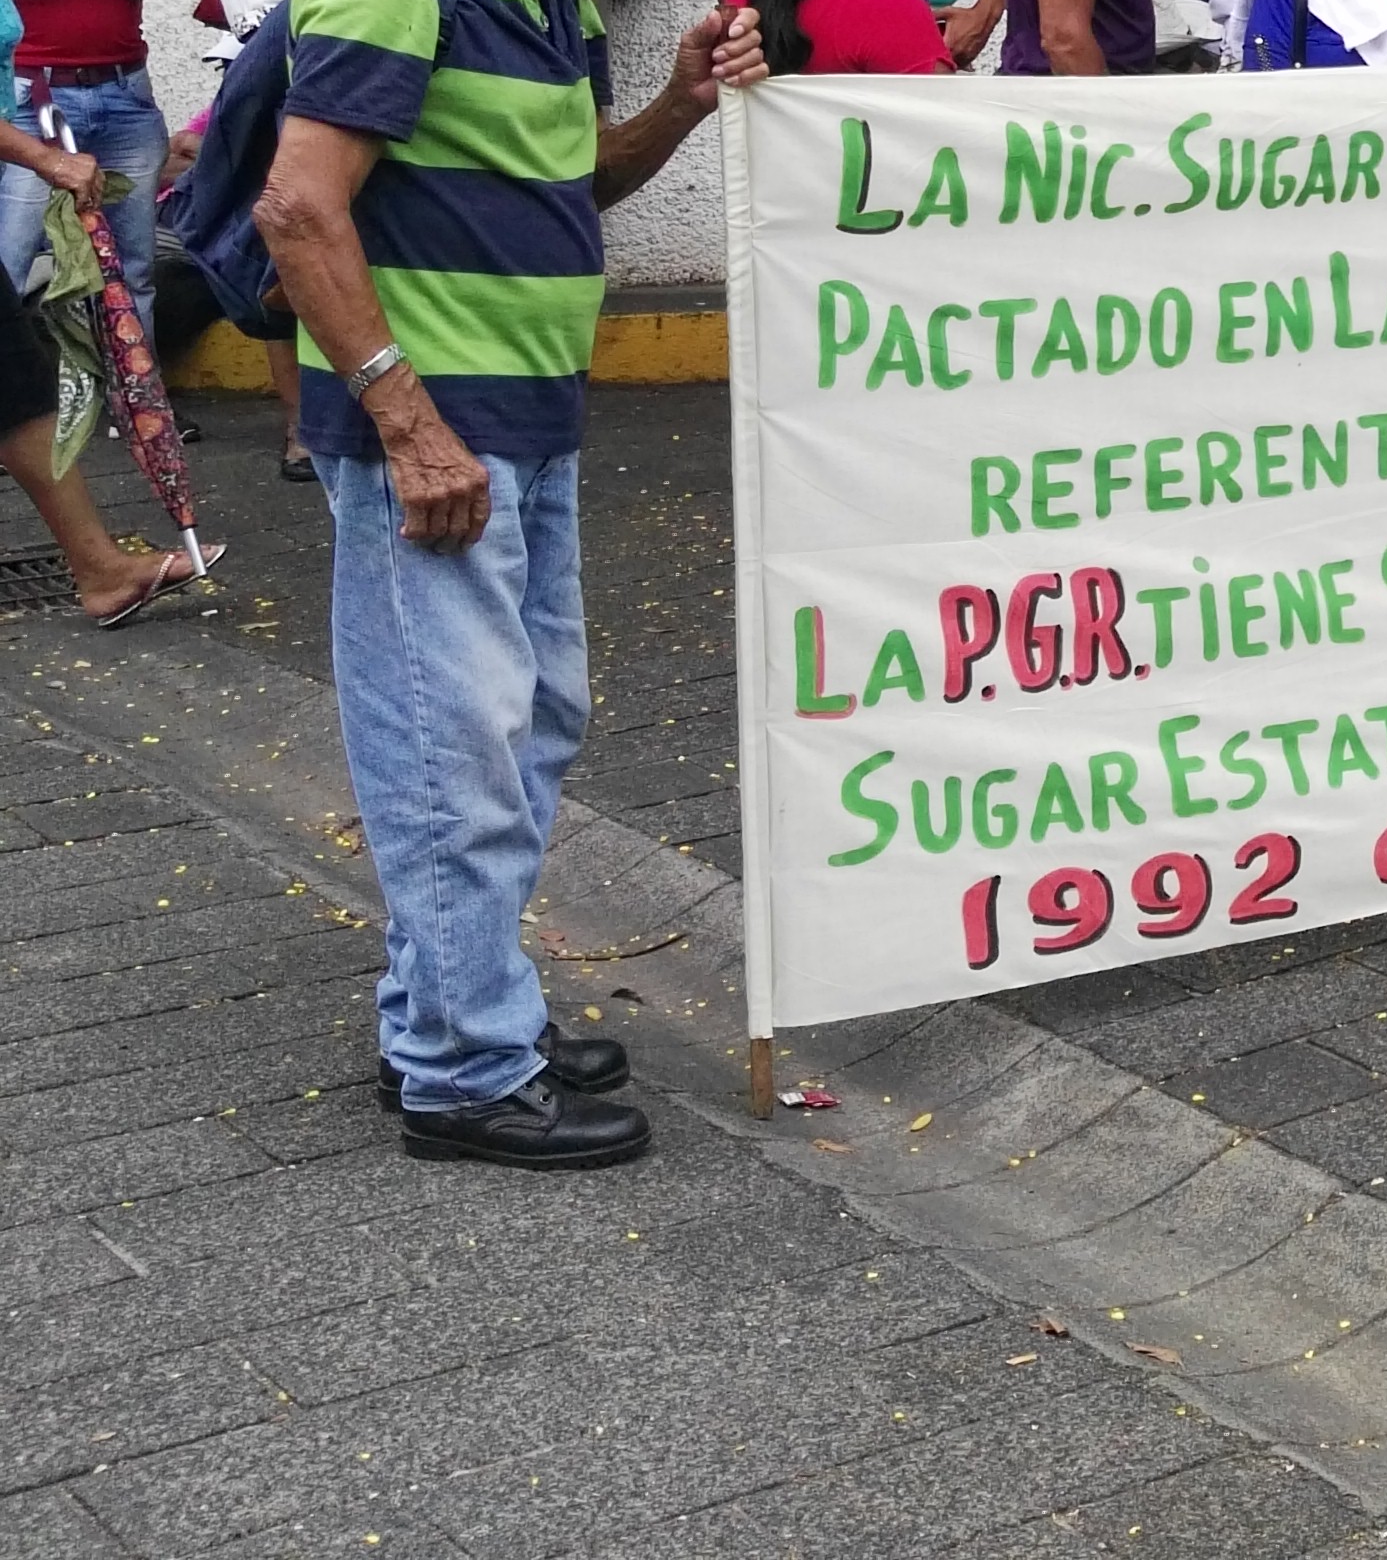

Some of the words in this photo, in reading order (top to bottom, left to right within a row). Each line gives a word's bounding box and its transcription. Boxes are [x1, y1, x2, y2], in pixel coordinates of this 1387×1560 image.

[836, 120, 967, 234] LA
[1165, 115, 1383, 212] SUGAR
[820, 281, 1191, 388] PACTADO
[1217, 278, 1312, 362] EN
[796, 608, 923, 718] LA
[830, 752, 1144, 864] SUGAR
[963, 833, 1301, 970] 1992
